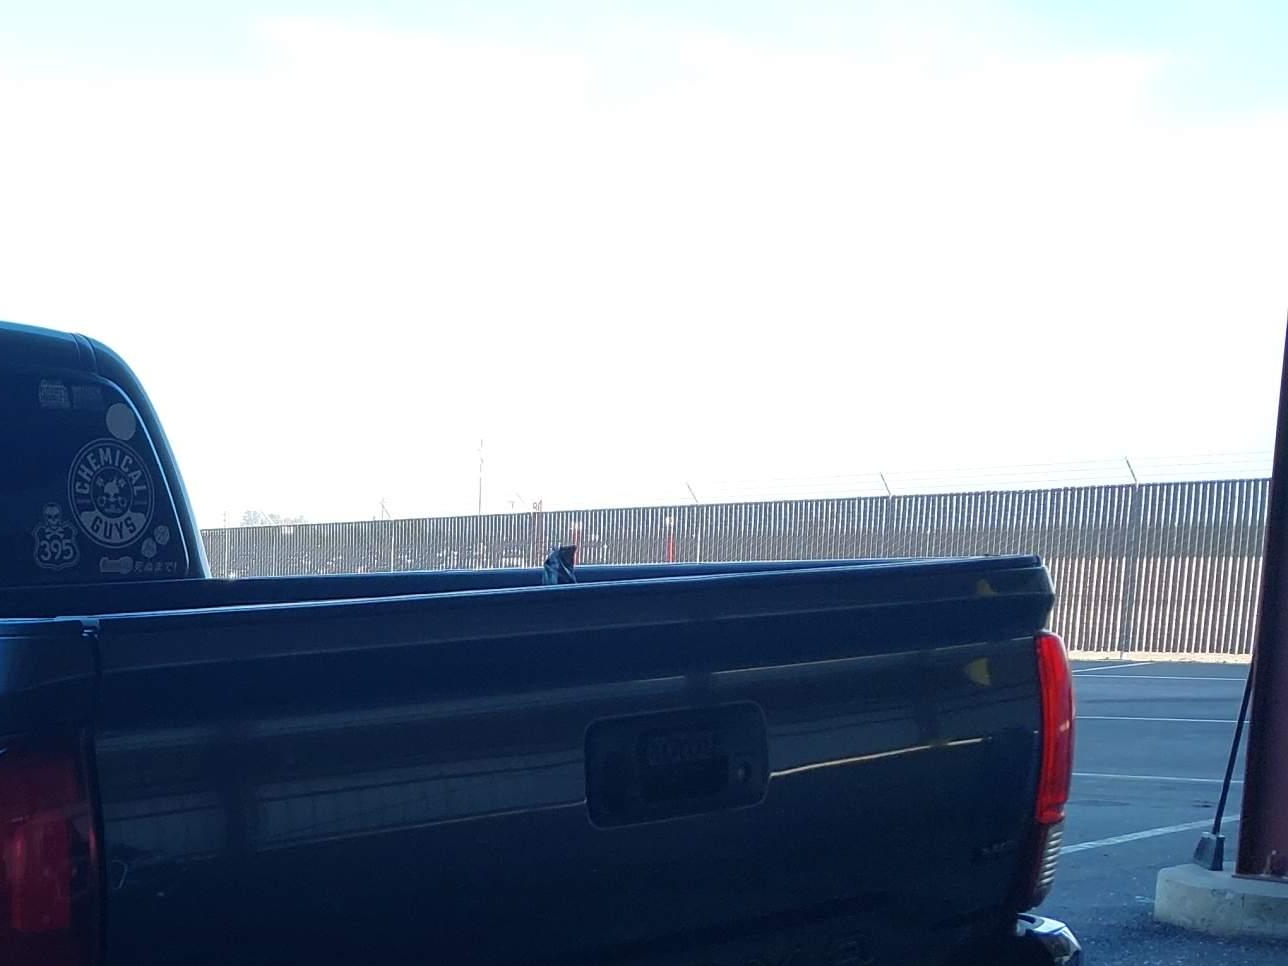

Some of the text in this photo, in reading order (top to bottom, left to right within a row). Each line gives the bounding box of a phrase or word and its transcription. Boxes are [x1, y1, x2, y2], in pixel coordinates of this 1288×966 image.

[75, 446, 148, 496] CHEMICAL
[90, 515, 137, 540] GUYS
[38, 538, 73, 562] 395
